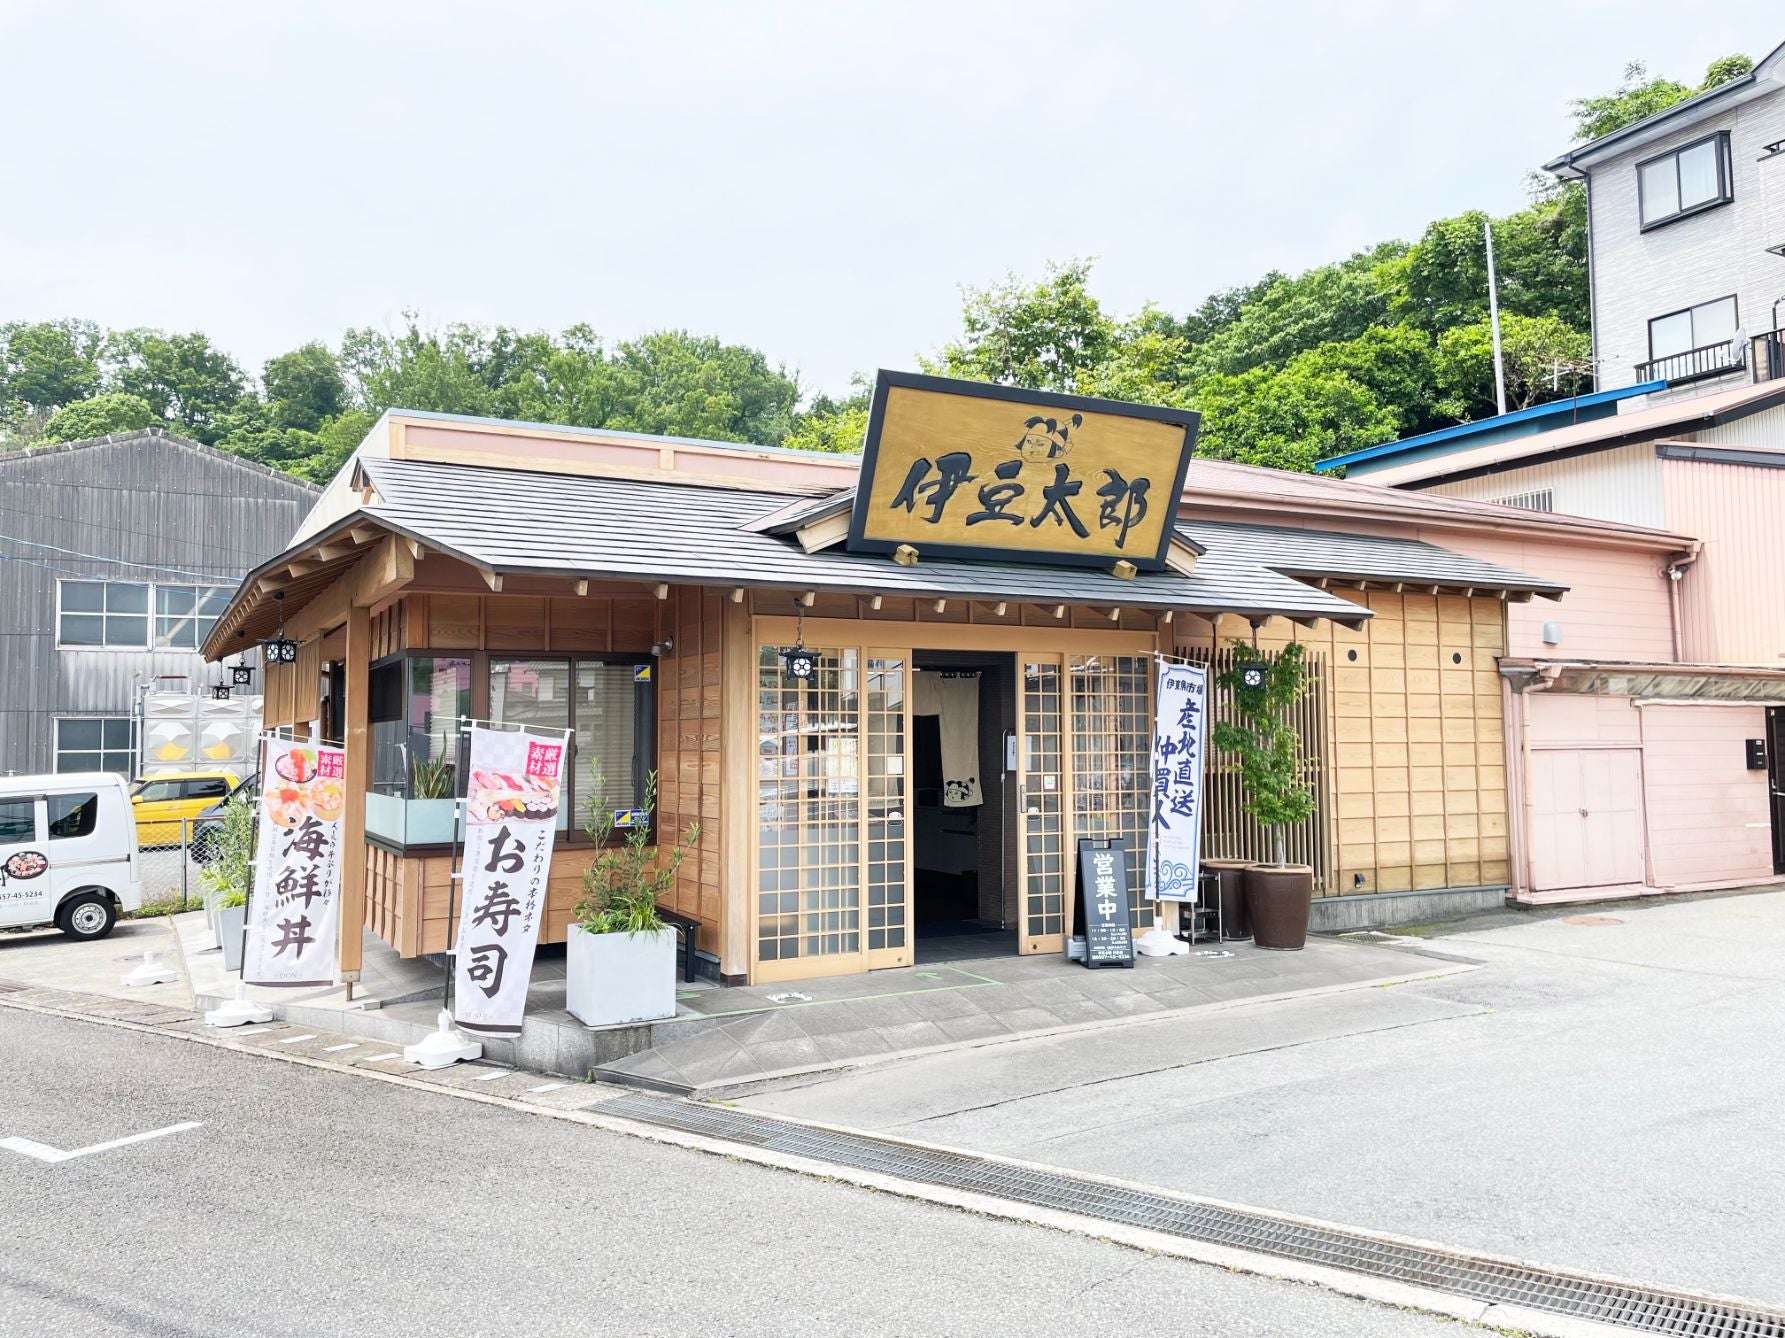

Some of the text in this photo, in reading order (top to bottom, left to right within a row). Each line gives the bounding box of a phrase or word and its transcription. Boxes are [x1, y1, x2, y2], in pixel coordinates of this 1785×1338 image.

[889, 451, 1151, 549] 伊豆太郎
[529, 746, 544, 774] 素材
[542, 747, 559, 775] 厳選
[1170, 697, 1200, 817] 産地直送
[271, 816, 329, 960] 海鮮丼
[467, 825, 526, 999] お寿司
[1093, 852, 1118, 921] 営業中
